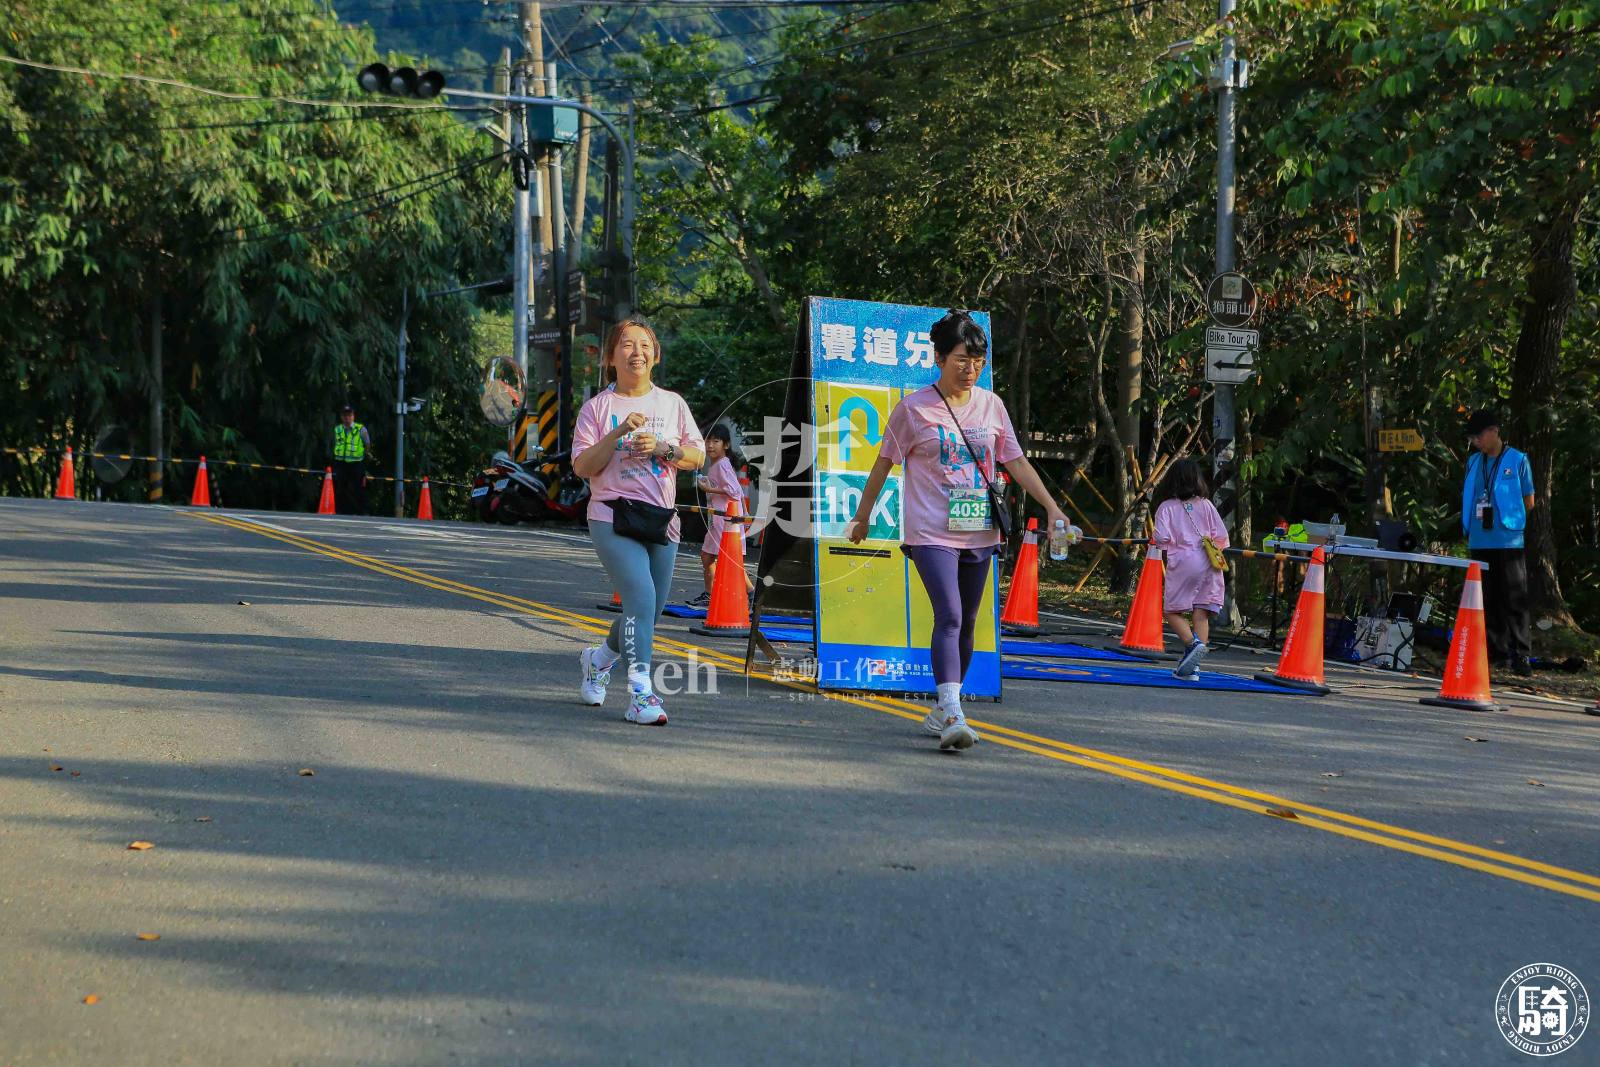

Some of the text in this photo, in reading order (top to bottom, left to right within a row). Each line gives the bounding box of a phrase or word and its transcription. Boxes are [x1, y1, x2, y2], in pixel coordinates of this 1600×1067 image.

[1212, 300, 1251, 315] 獅頭山
[1209, 331, 1225, 343] Bike
[1228, 332, 1244, 344] Tour
[824, 485, 896, 528] 10K
